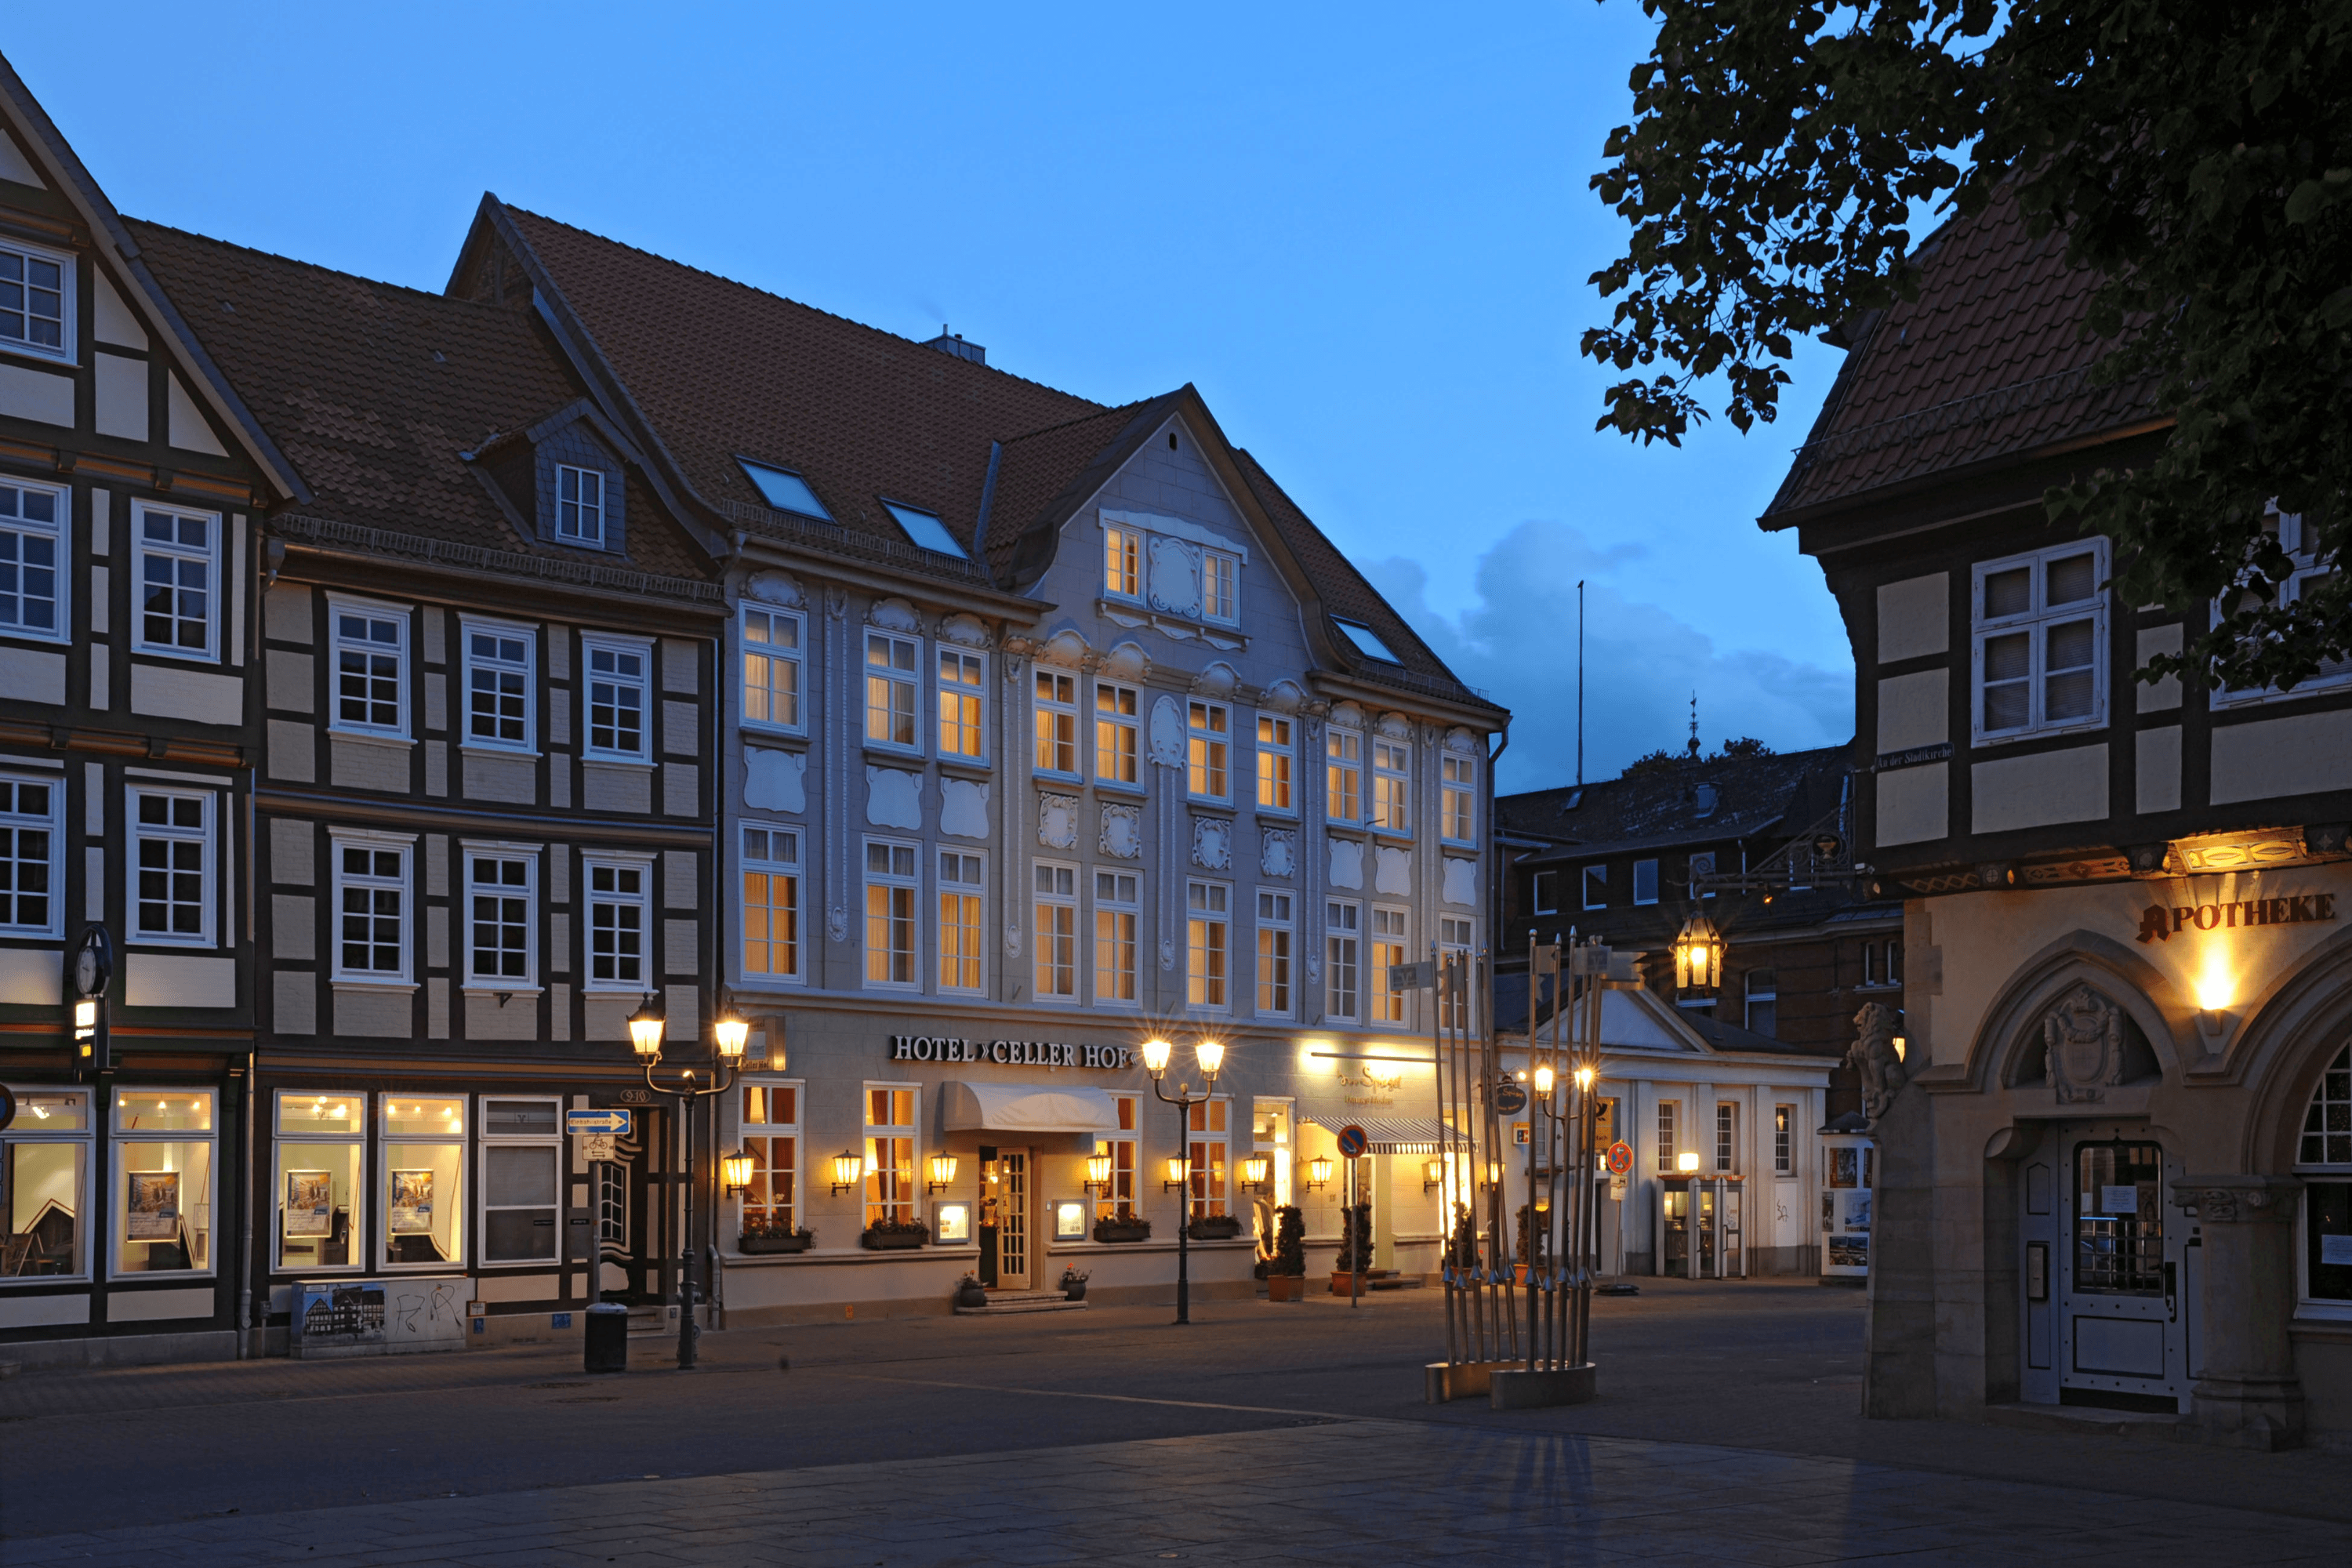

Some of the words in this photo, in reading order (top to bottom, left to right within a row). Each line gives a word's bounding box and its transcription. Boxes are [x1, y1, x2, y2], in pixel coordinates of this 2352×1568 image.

[1878, 757, 1888, 768] An
[1889, 754, 1903, 766] der
[1904, 746, 1951, 764] Stadtkirche
[2136, 894, 2335, 943] APOTHEKE
[895, 1036, 975, 1062] HOTEL
